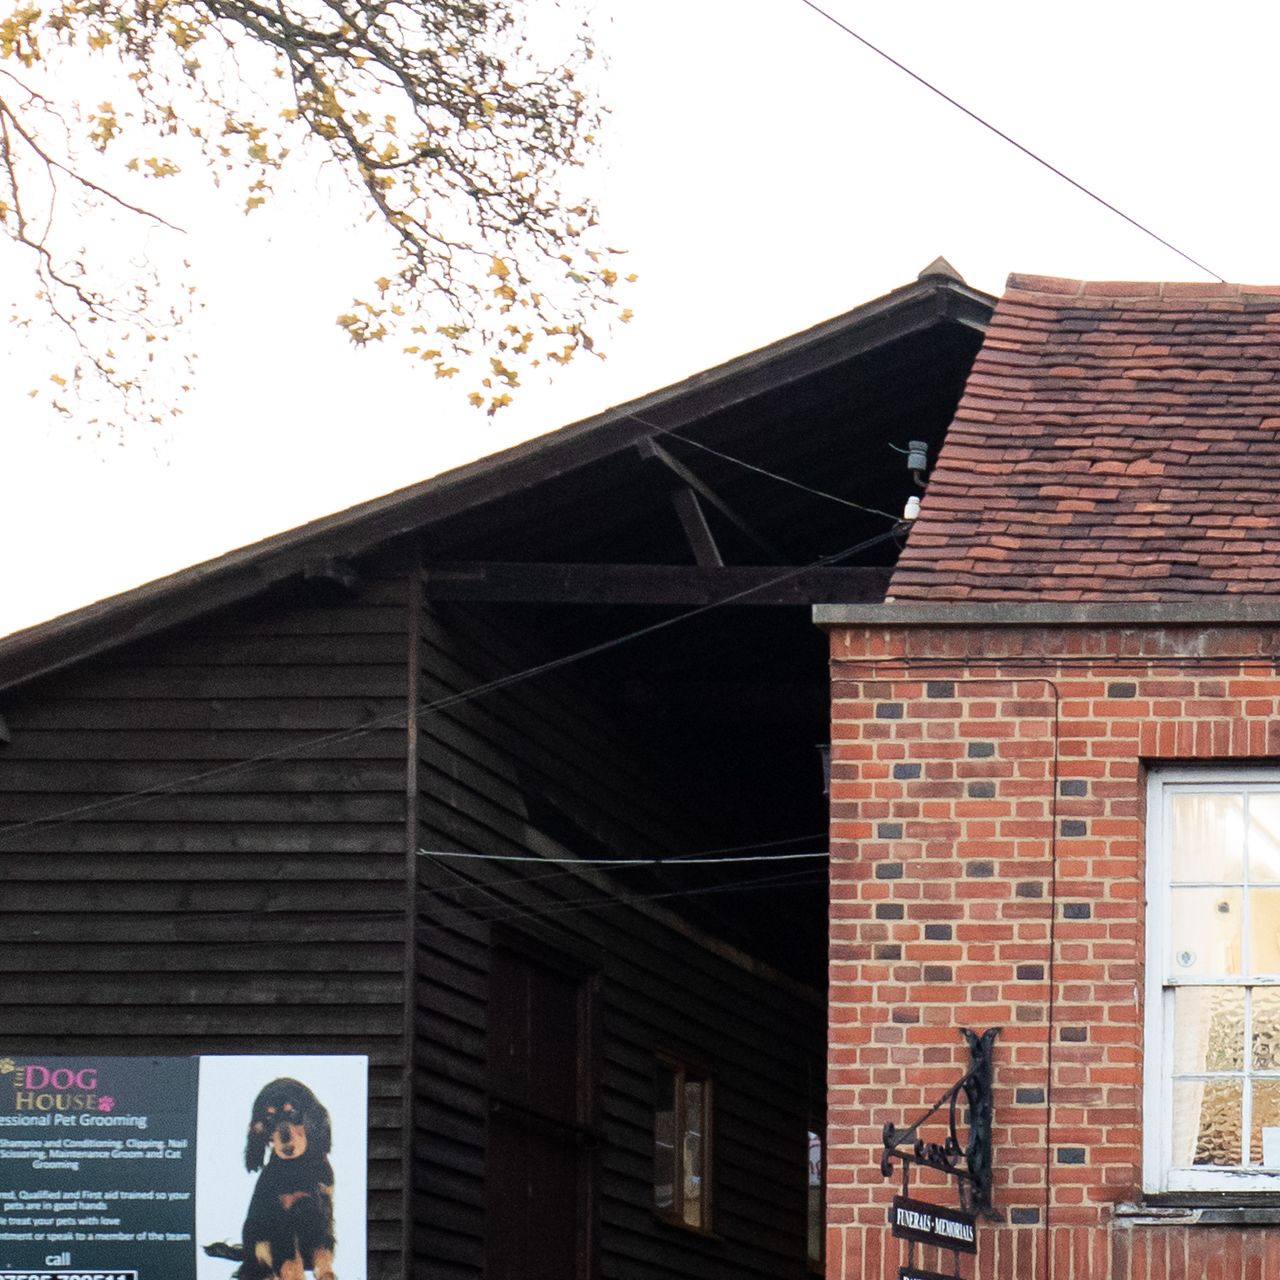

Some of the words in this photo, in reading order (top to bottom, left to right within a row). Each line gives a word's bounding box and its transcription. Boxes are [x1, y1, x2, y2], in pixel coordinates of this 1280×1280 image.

[25, 1065, 98, 1089] DOG
[15, 1091, 98, 1110] HOUSE
[54, 1114, 77, 1126] Pet
[80, 1114, 149, 1130] Grooming
[32, 1160, 79, 1171] Grooming
[62, 1190, 80, 1199] and
[53, 1202, 77, 1212] good
[78, 1201, 108, 1210] hands
[897, 1208, 931, 1232] FUNERALS
[934, 1218, 974, 1242] MEMORIALS
[45, 1252, 71, 1266] call
